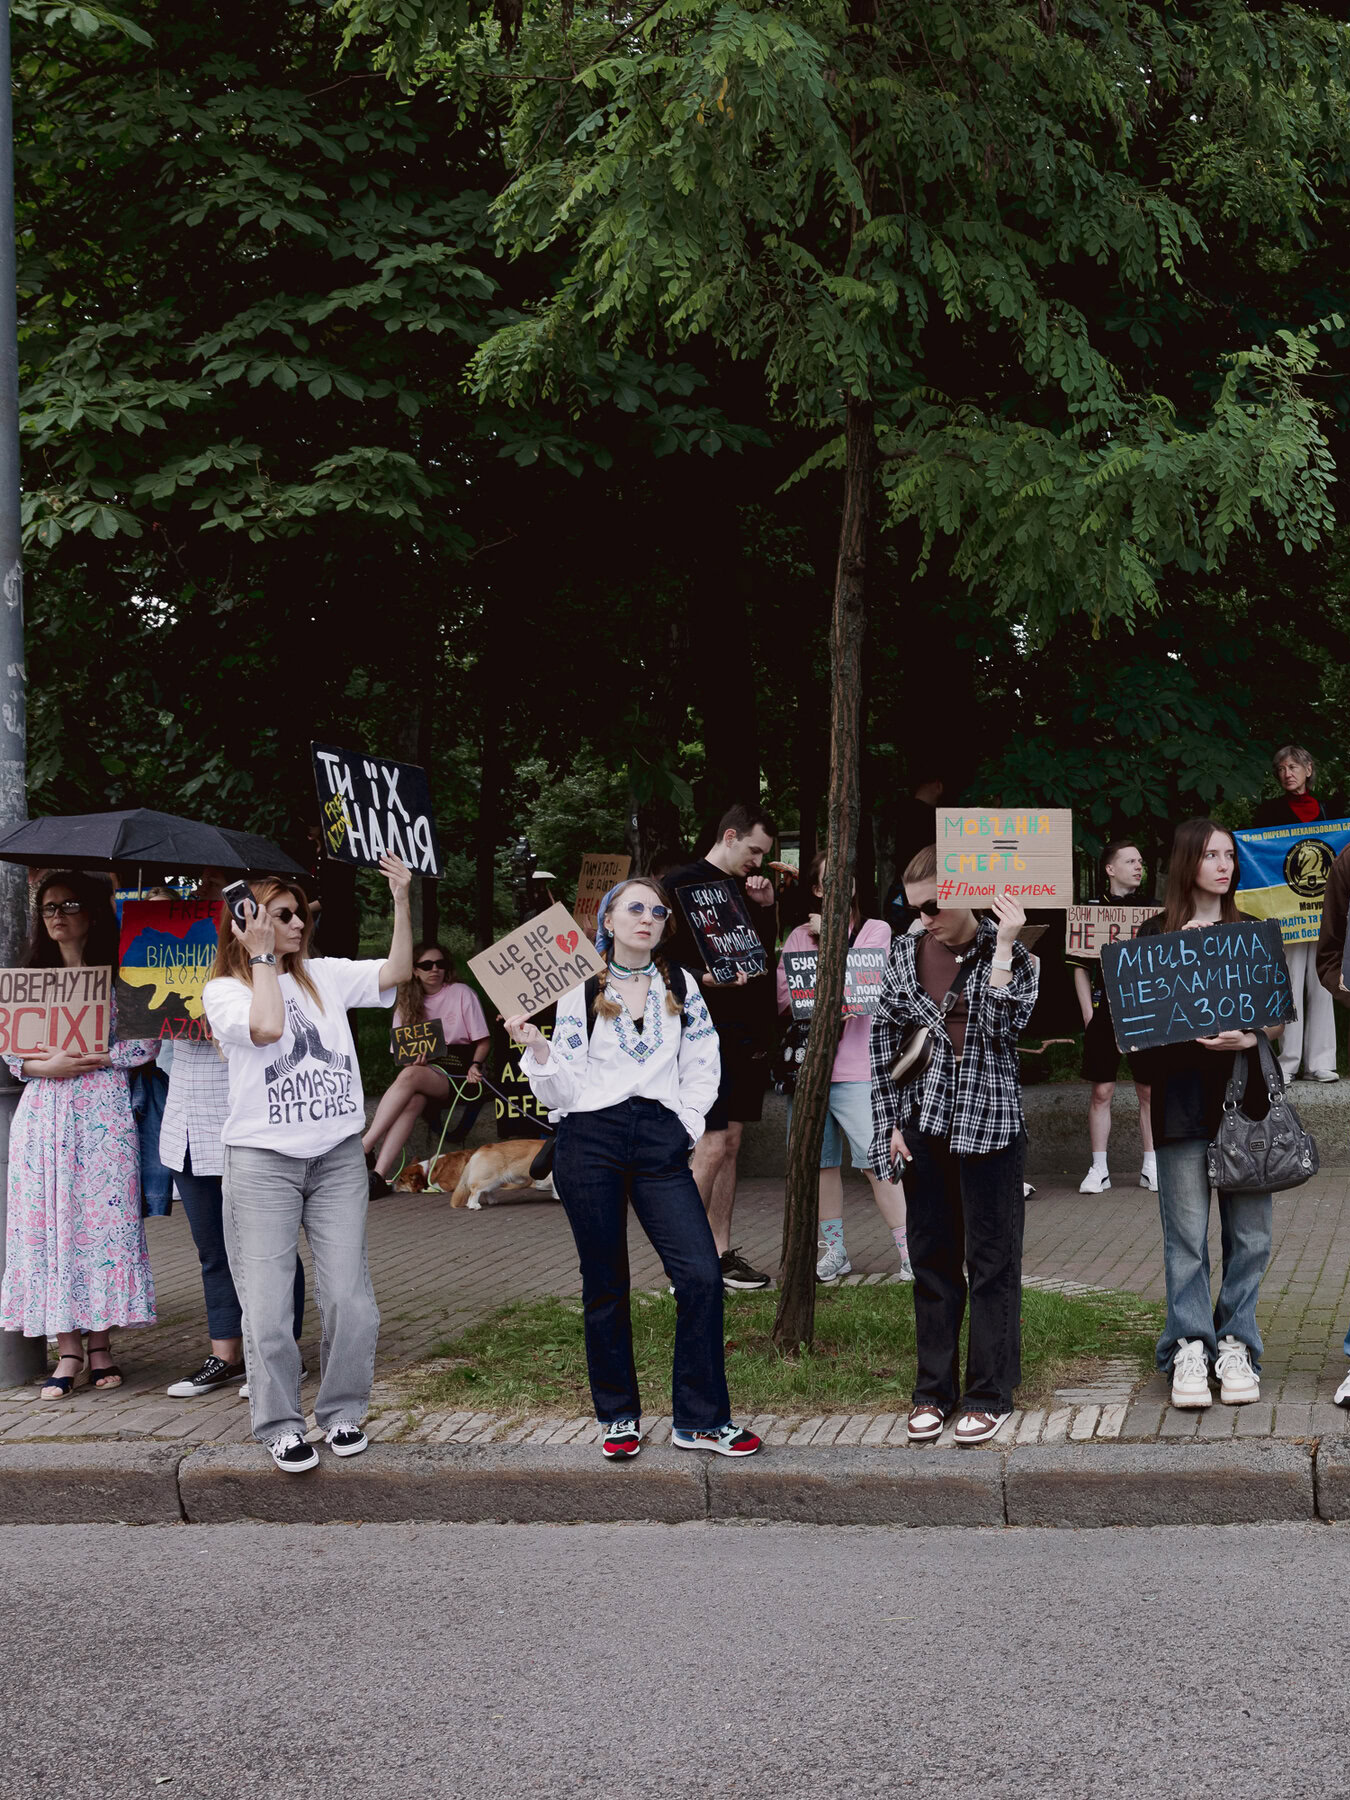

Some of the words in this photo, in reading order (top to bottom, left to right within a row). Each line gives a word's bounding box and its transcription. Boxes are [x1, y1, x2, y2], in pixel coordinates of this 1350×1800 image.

[944, 852, 1026, 874] СМЕРТЬ
[1299, 901, 1324, 911] Магур
[1069, 923, 1095, 949] НЕ
[791, 956, 818, 971] БУД
[846, 953, 884, 968] ЛОСОМ
[0, 969, 107, 1003] ОВЕРНУТИ
[1119, 962, 1286, 1008] НЕЗЛАМНІСТЬ
[1166, 993, 1255, 1035] АЗОВ
[395, 1022, 433, 1043] FREE
[398, 1037, 437, 1060] AZOV
[268, 1069, 353, 1103] NAMASTE
[268, 1093, 357, 1125] BITCHES
